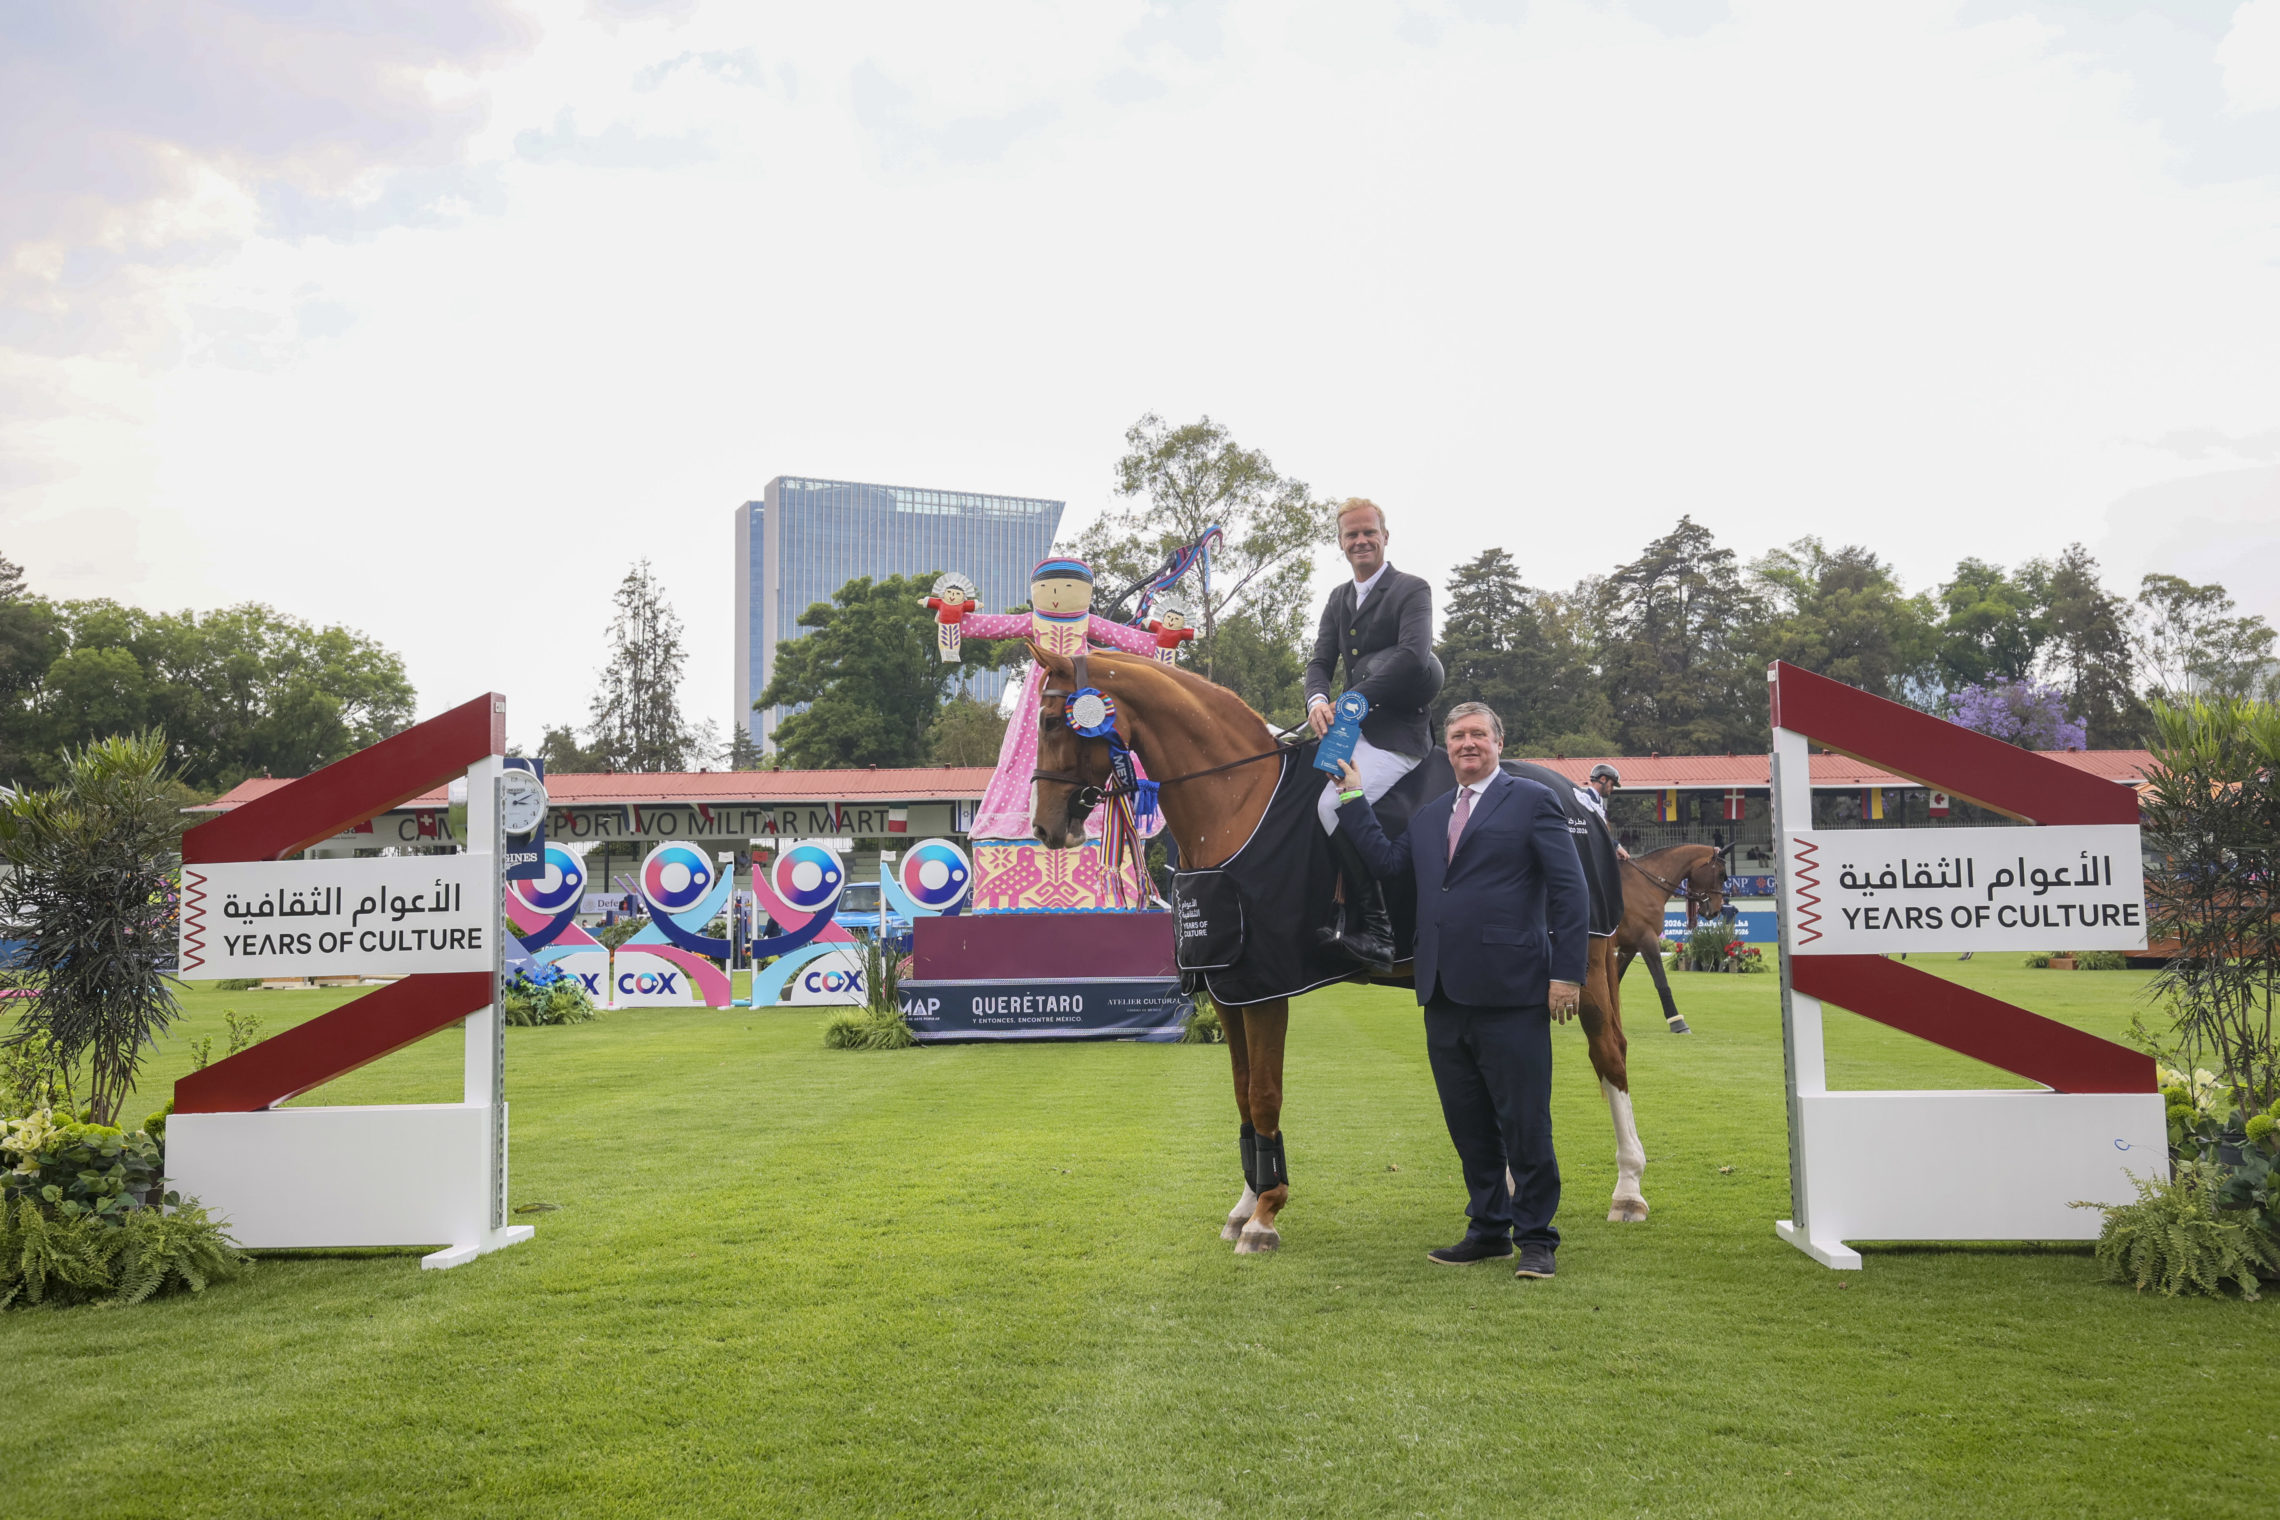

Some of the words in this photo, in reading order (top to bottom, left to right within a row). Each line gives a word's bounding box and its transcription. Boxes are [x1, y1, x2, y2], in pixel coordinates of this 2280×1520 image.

[808, 809, 890, 834] MART
[1839, 857, 1975, 897] الثقافية
[1987, 850, 2112, 902] الأعوام
[223, 886, 342, 925] الثقافية
[352, 878, 461, 928] الأعوام
[1841, 906, 1944, 930] YEARS
[1950, 905, 1991, 928] OF
[1997, 903, 2140, 928] CULTURE
[1199, 920, 1208, 928] OF
[223, 932, 312, 957] YEARS
[318, 931, 354, 954] OF
[359, 927, 482, 952] CULTURE
[618, 972, 677, 995] COX
[805, 970, 864, 993] COX
[972, 991, 1083, 1016] QUERÉTARO
